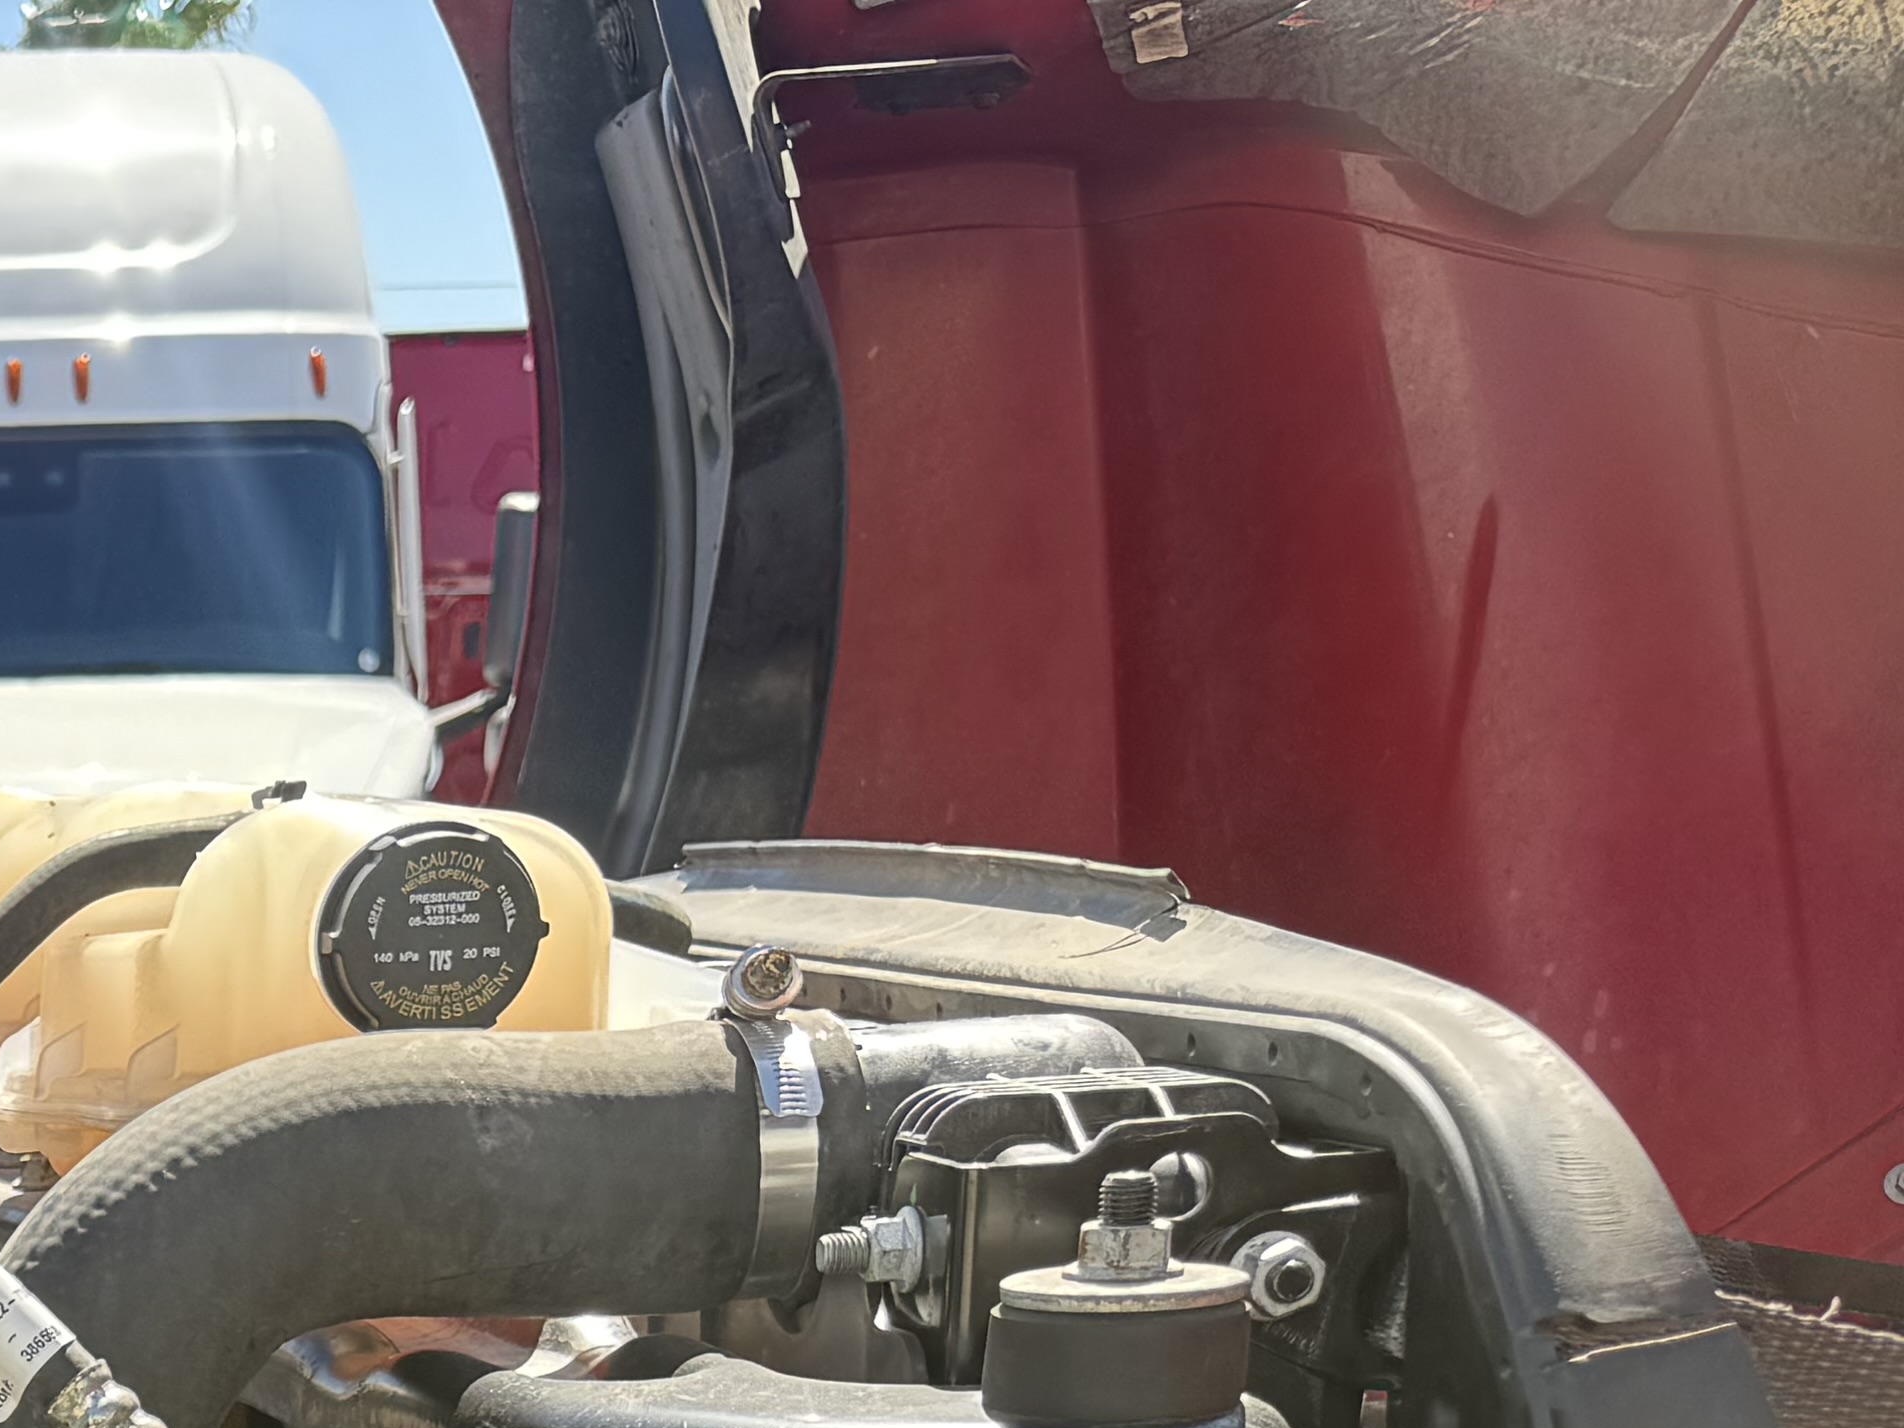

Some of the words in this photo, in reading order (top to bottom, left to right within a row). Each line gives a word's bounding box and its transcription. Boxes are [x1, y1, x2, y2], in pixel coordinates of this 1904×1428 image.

[420, 850, 484, 872] CAUTION
[400, 872, 438, 896] NEVER
[438, 869, 468, 883] OPEN
[467, 875, 490, 893] HOT
[409, 891, 480, 904] PRESSURIZED
[423, 903, 466, 914] SYSTEM
[374, 953, 393, 963] 140
[429, 950, 452, 972] TVS
[463, 948, 477, 959] 20
[483, 947, 500, 958] PSI
